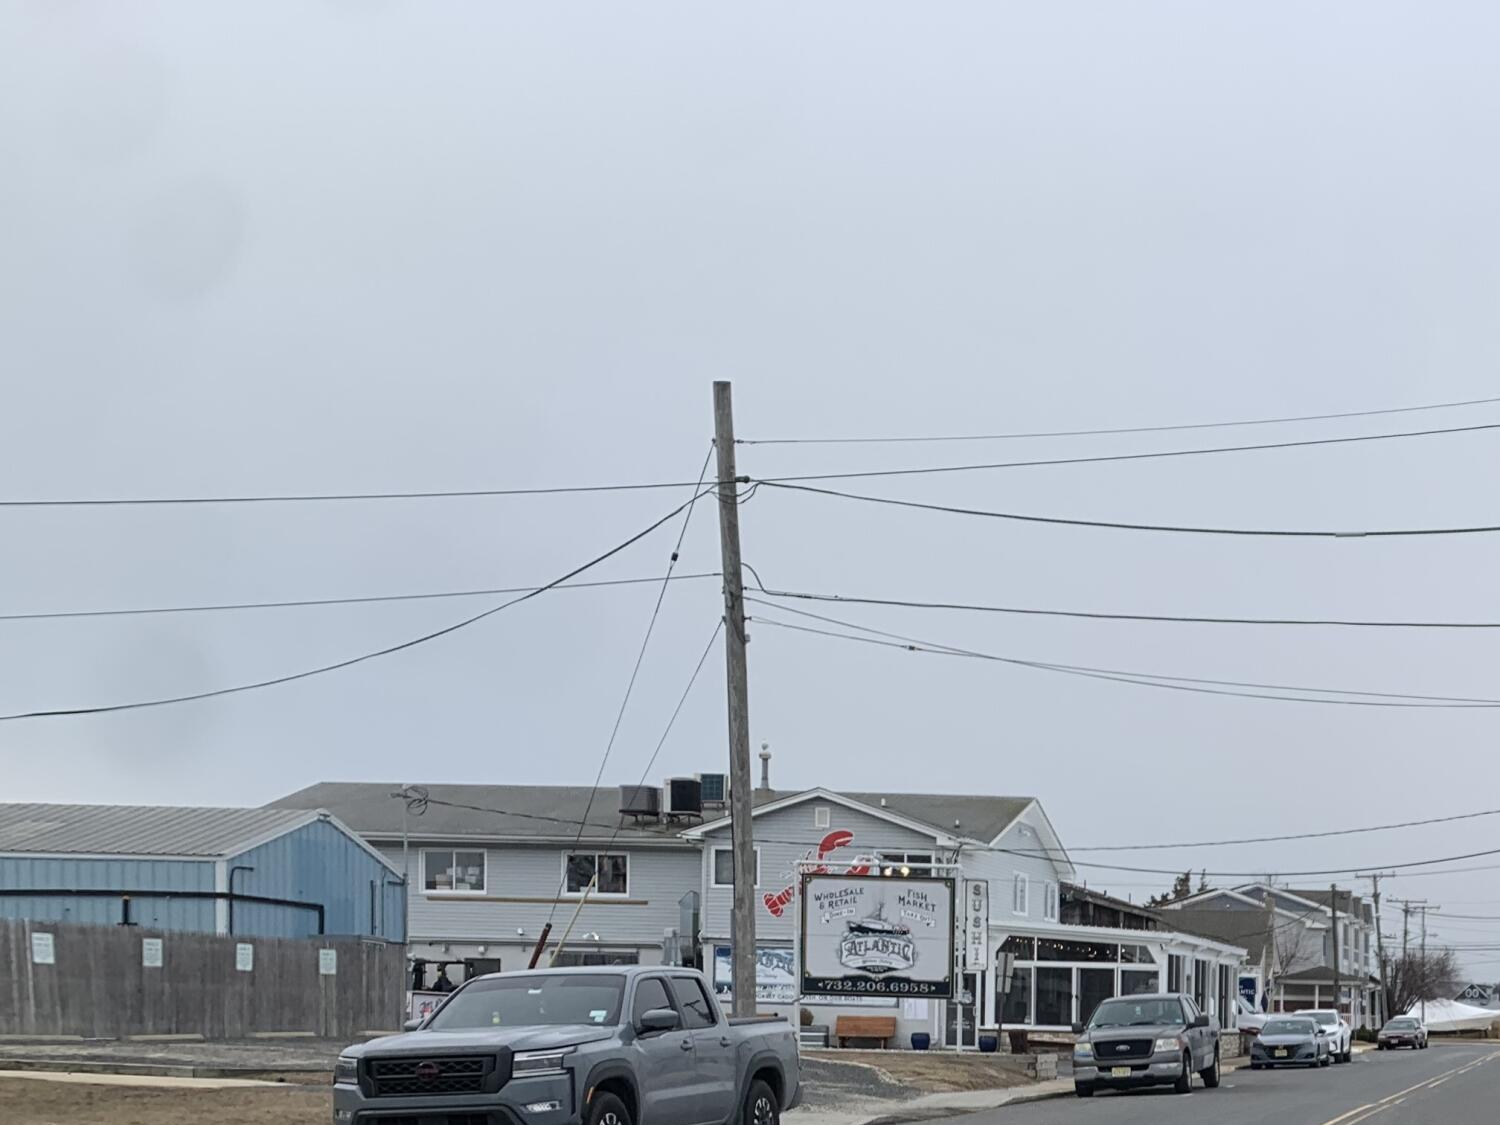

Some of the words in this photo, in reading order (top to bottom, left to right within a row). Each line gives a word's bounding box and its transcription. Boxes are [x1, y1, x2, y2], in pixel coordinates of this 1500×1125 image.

[814, 887, 864, 901] WHOLESALE
[907, 888, 928, 902] FISH
[828, 896, 857, 909] RETAIL
[898, 896, 936, 912] MARKET
[972, 884, 983, 962] SUSHI
[844, 940, 911, 962] ATLANTIC
[824, 979, 929, 994] 732.206.6958
